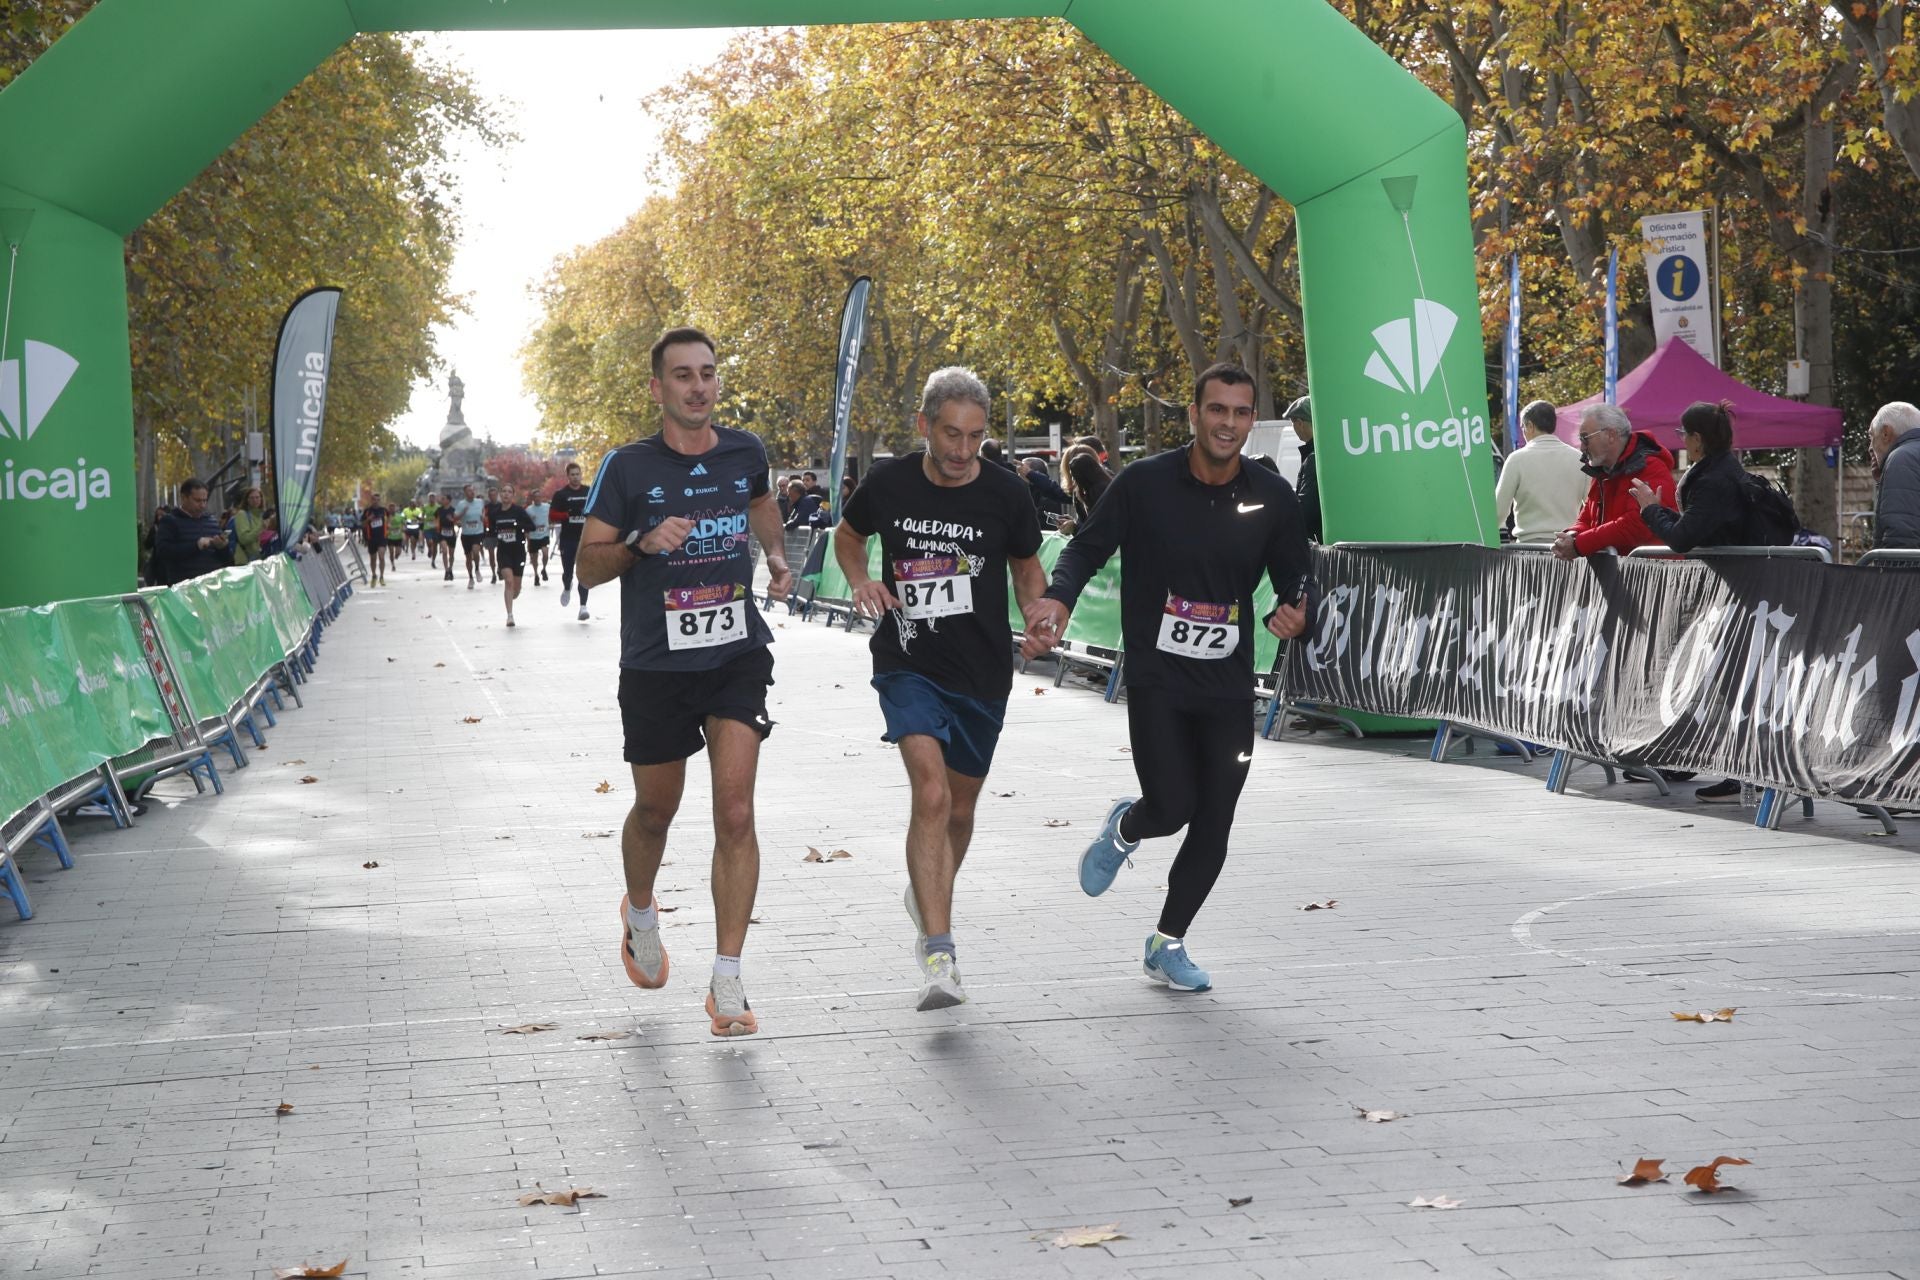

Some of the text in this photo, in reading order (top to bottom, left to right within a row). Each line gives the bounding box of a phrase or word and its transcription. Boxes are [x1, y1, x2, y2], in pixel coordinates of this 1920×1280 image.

[1650, 223, 1676, 232] Oficina
[295, 352, 326, 472] Unicaja
[1341, 406, 1485, 457] Unicaja
[0, 457, 111, 511] icaja
[695, 486, 718, 495] ZURICH
[687, 514, 747, 540] ADRID
[902, 517, 974, 541] QUEDADA
[685, 536, 736, 556] CIELO
[906, 537, 953, 553] ALUMNOS
[688, 556, 725, 565] MARATHON
[904, 579, 954, 607] 871
[680, 606, 734, 636] 873
[1171, 620, 1227, 649] 872
[1730, 600, 1878, 750] Norte
